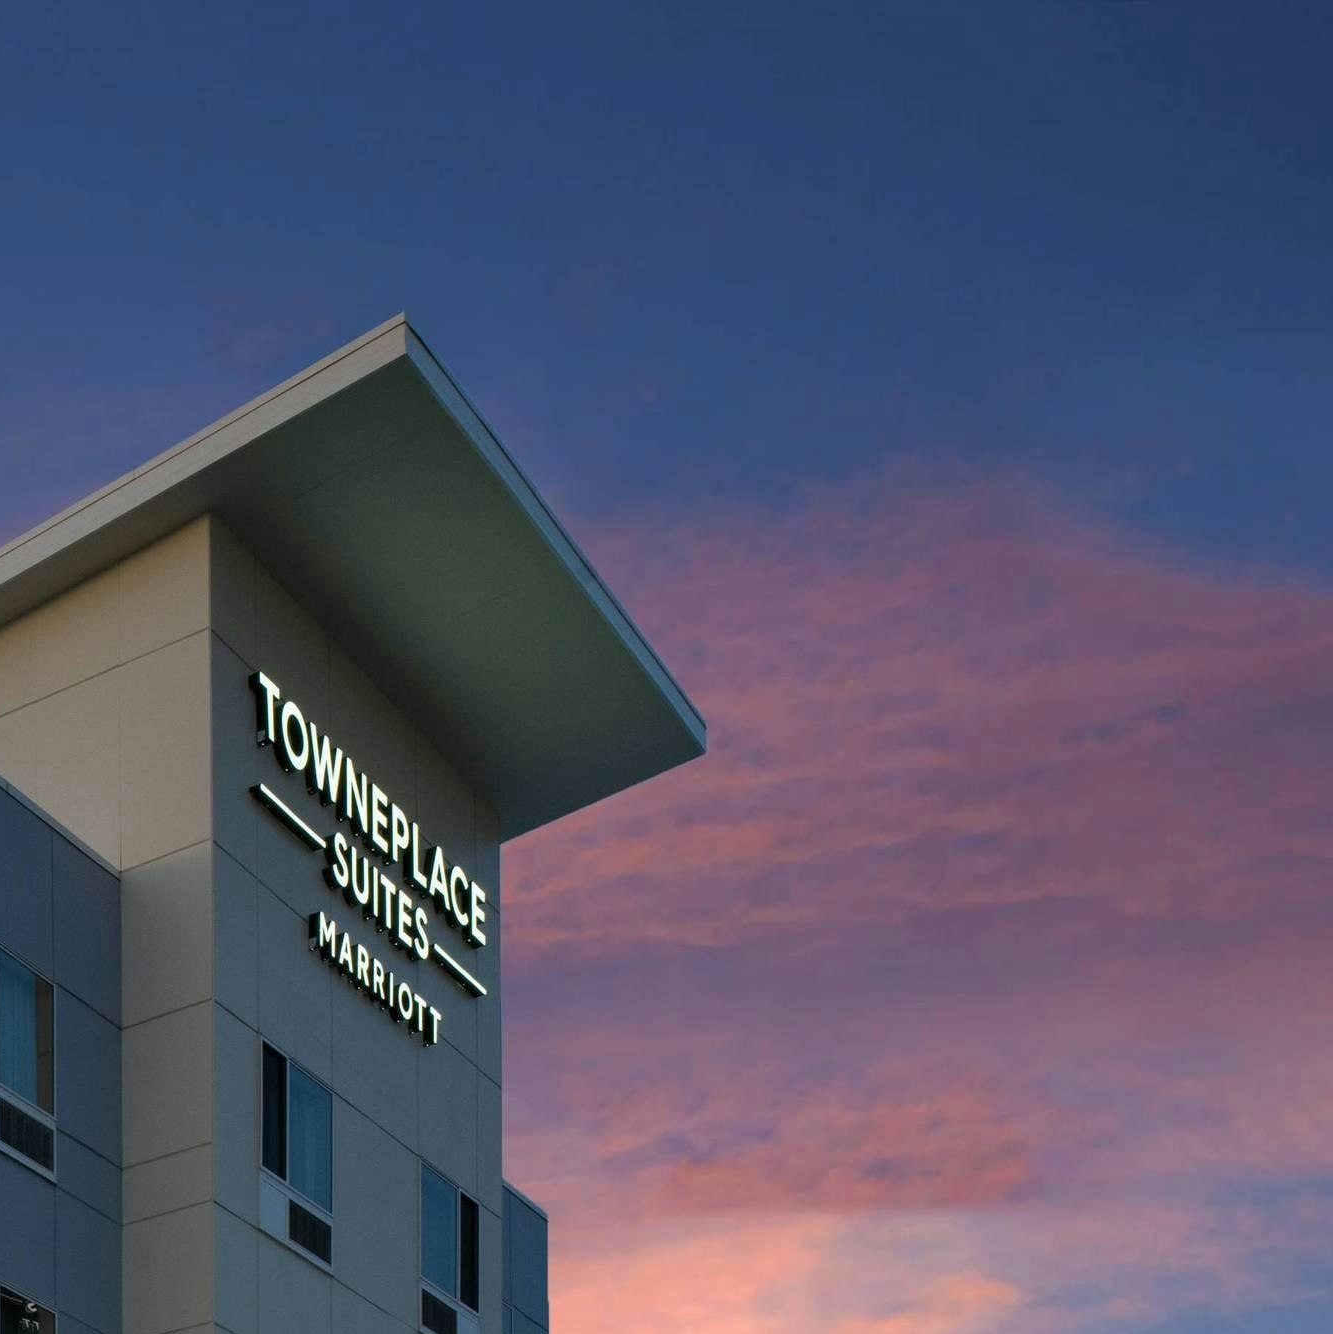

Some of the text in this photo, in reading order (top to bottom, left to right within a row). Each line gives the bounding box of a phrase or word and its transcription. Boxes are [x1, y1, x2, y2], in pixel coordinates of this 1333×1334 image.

[259, 671, 487, 946] TOWNEPLACE
[332, 832, 430, 960] SUITES
[319, 911, 442, 1044] MARRIOTT
